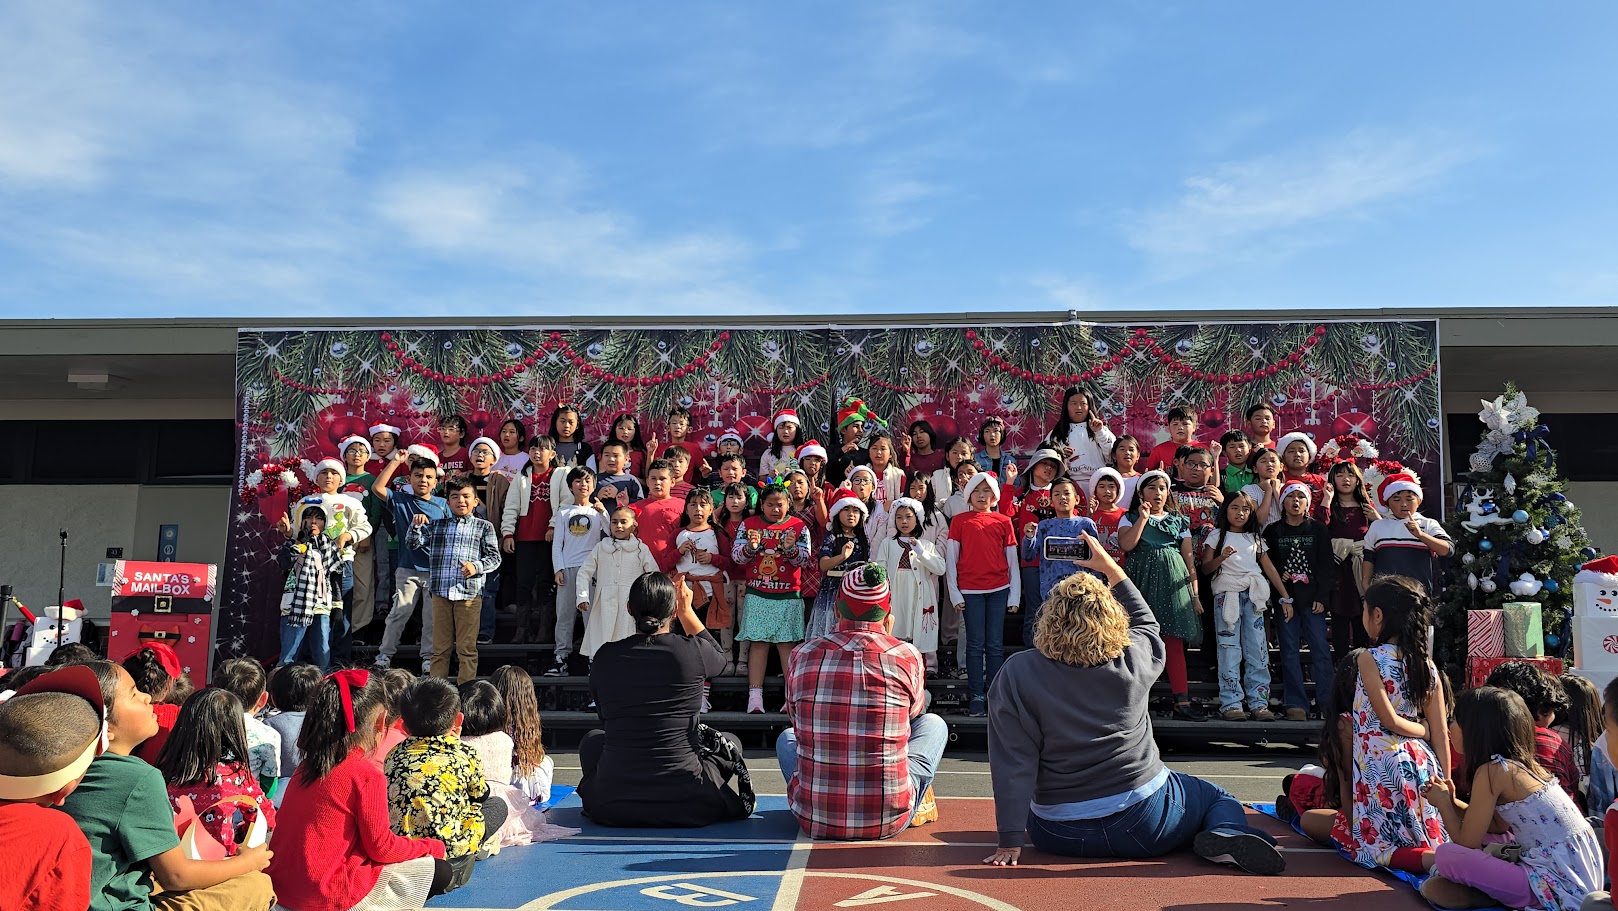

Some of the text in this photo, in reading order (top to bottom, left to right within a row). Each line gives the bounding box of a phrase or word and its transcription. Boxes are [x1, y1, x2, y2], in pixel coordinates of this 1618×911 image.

[440, 461, 464, 470] RADISE
[134, 571, 190, 584] SANTA'S
[131, 582, 190, 595] MAILBOX
